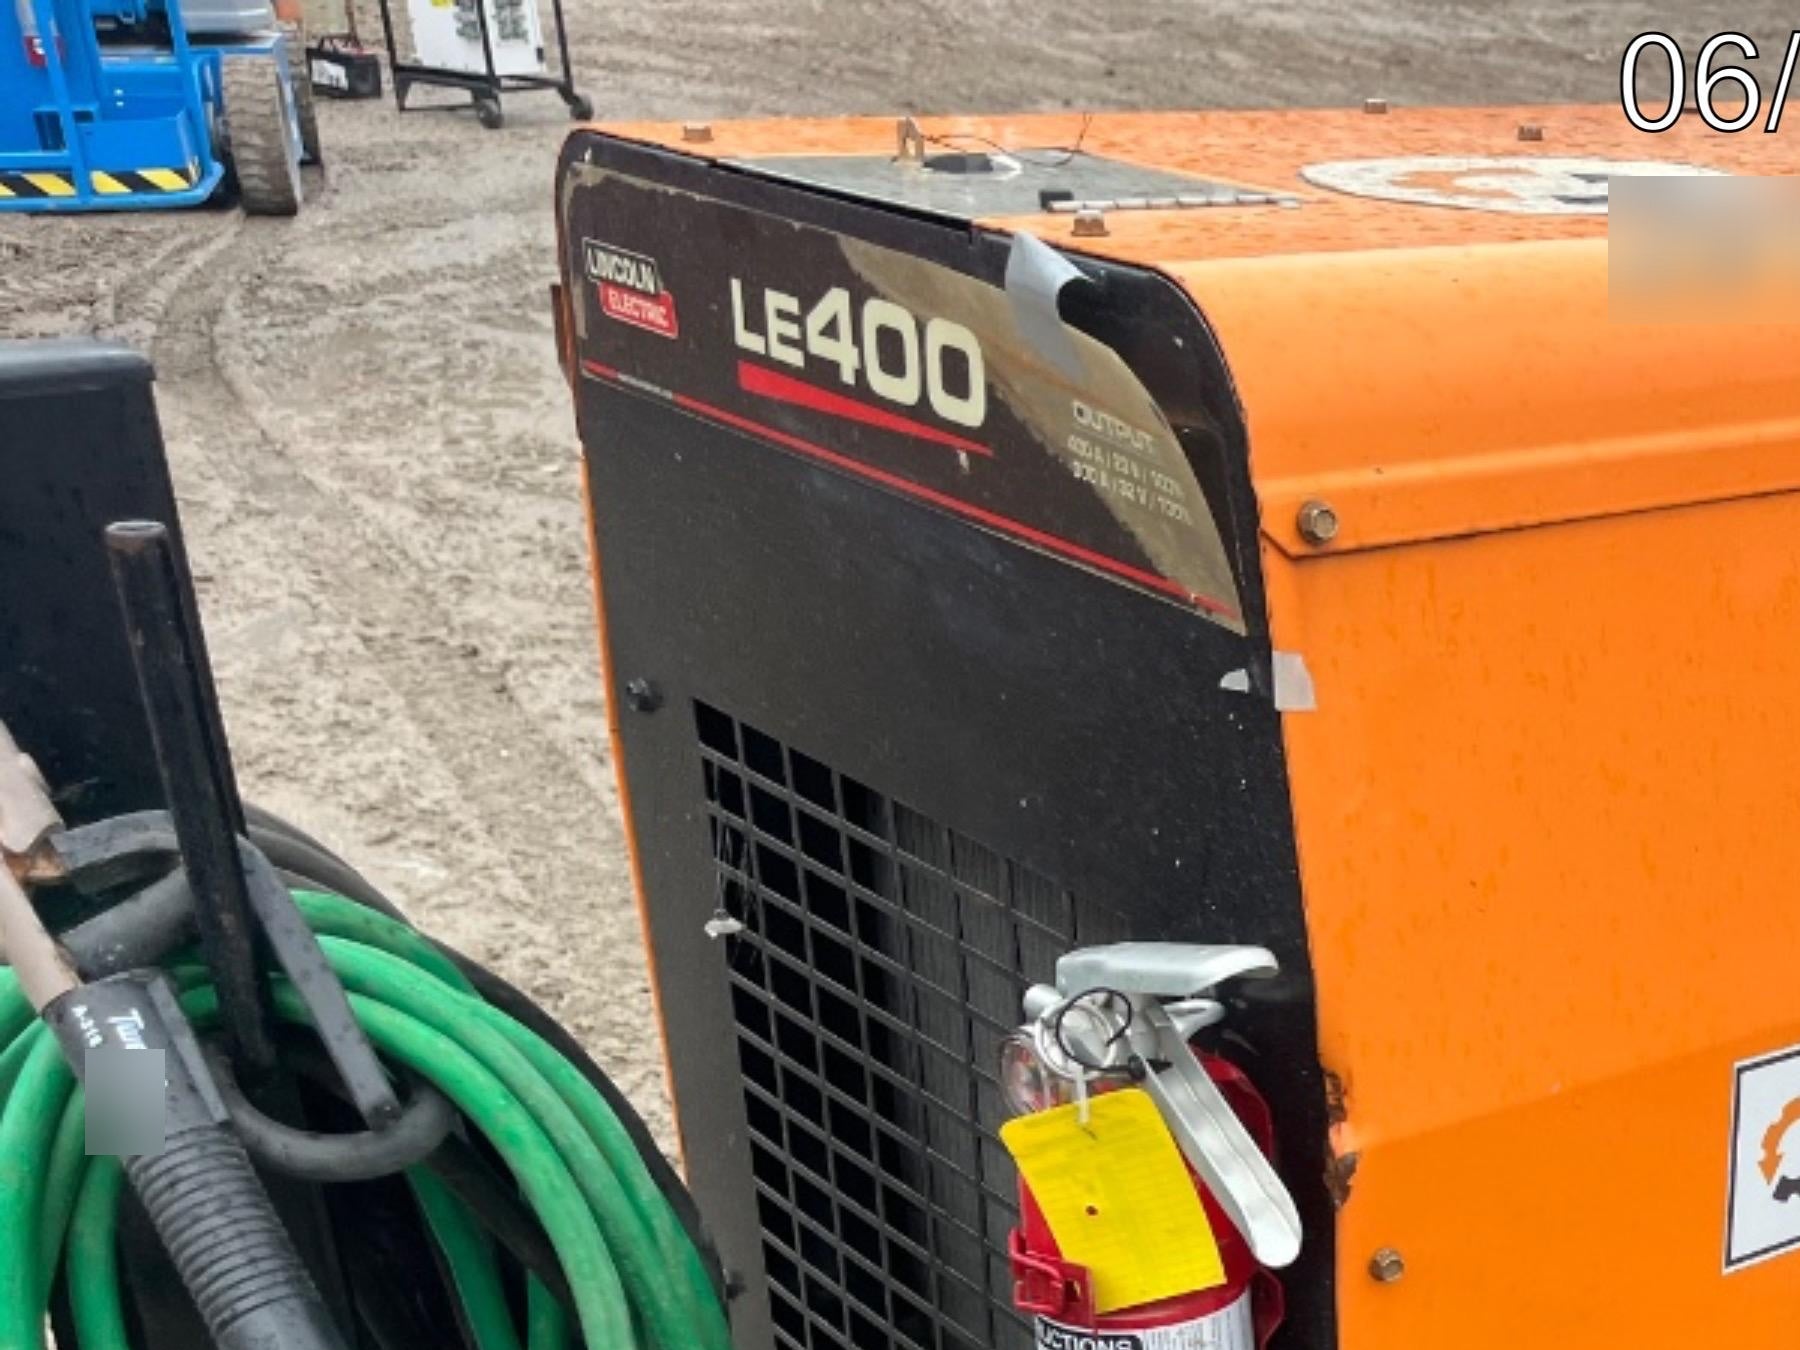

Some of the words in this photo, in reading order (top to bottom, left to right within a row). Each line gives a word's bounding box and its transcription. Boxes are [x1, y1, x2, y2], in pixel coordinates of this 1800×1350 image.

[585, 246, 656, 295] LINCOLN
[607, 287, 669, 329] ELECTRIC
[729, 277, 986, 429] LE400
[1072, 400, 1154, 455] OUTPUT
